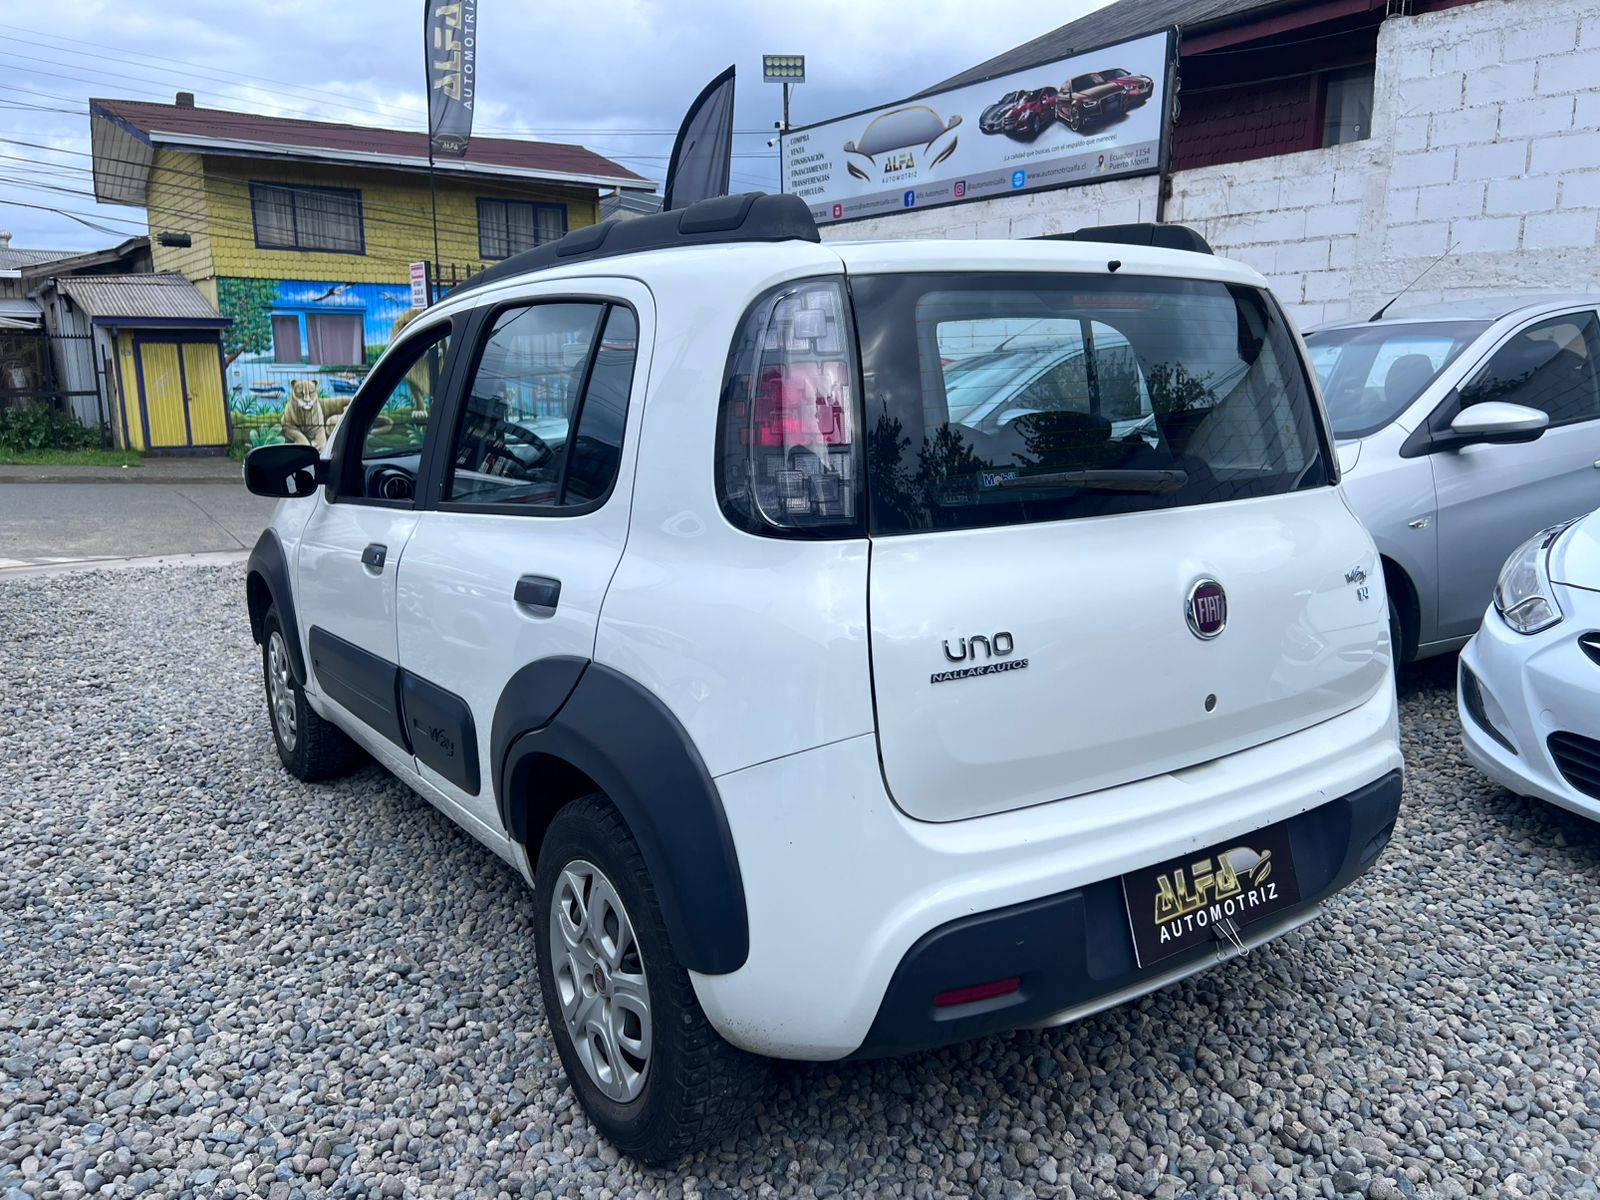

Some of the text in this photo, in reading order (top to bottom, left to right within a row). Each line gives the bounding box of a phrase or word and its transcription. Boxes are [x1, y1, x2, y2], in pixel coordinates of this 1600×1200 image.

[433, 1, 462, 101] ALFA
[790, 134, 810, 145] COMPRA
[790, 146, 805, 155] VENTA
[1109, 147, 1151, 162] Ecuador 1154
[791, 163, 828, 177] FINANCIAMIENTO
[884, 152, 915, 173] ALFA
[1109, 157, 1149, 170] Puerto Montt
[792, 173, 830, 188] TRANSFERENCIAS
[882, 171, 917, 183] AUTOMOTRIZ
[1197, 595, 1220, 624] FIAT
[931, 658, 1029, 683] NALLAR AUTOS
[1154, 853, 1241, 925] ALFA
[1160, 882, 1278, 944] AUTOMOTRIZ
